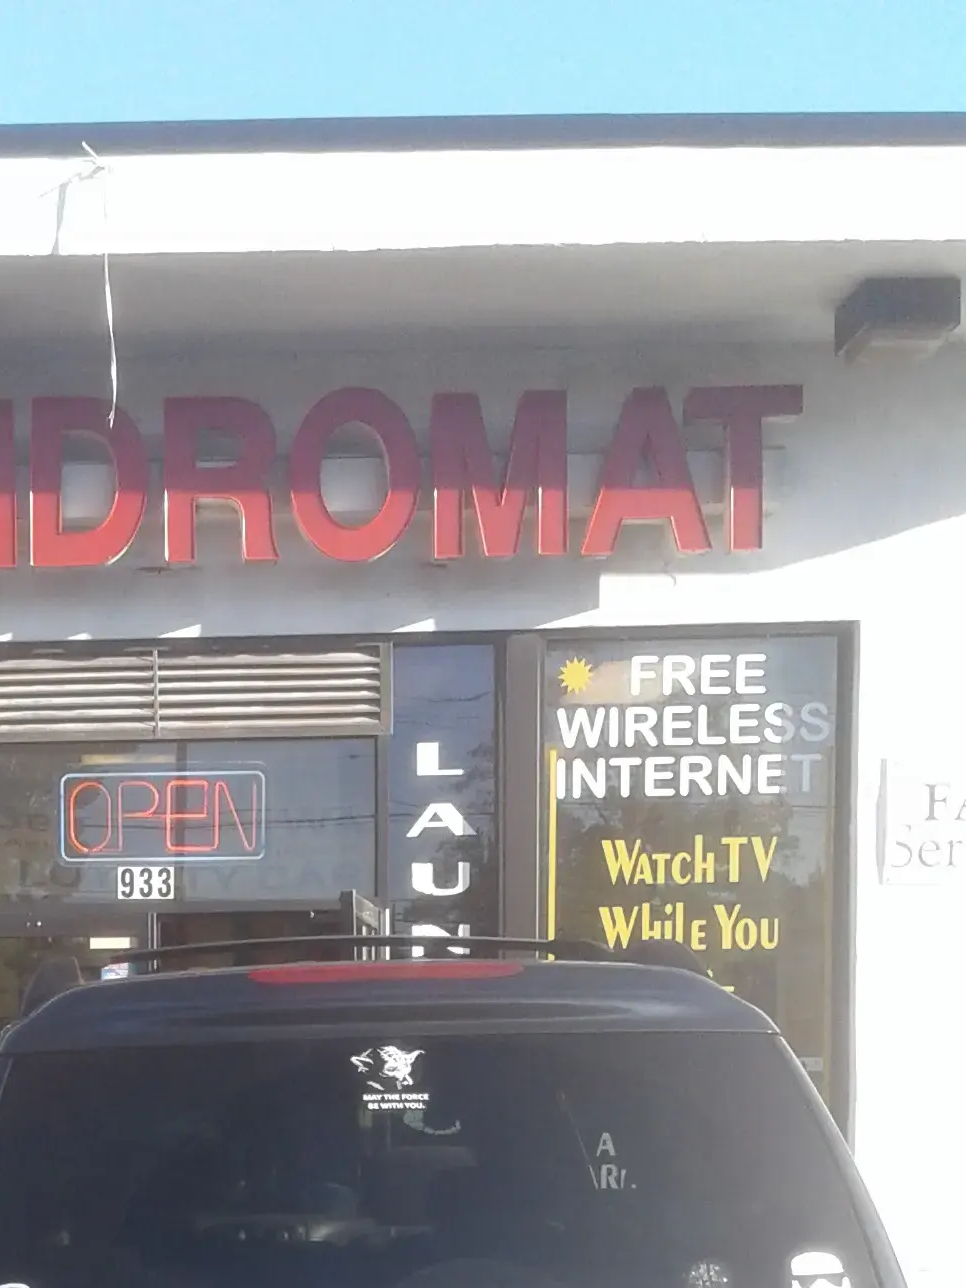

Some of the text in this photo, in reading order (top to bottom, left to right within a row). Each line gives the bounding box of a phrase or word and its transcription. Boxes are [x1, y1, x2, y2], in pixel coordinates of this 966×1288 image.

[629, 653, 768, 697] FREE
[556, 701, 830, 750] WIRELESS
[555, 752, 824, 800] INTERNET
[69, 779, 258, 854] OPEN
[120, 867, 172, 898] 933
[601, 834, 778, 886] Watch TV
[599, 902, 779, 951] While You
